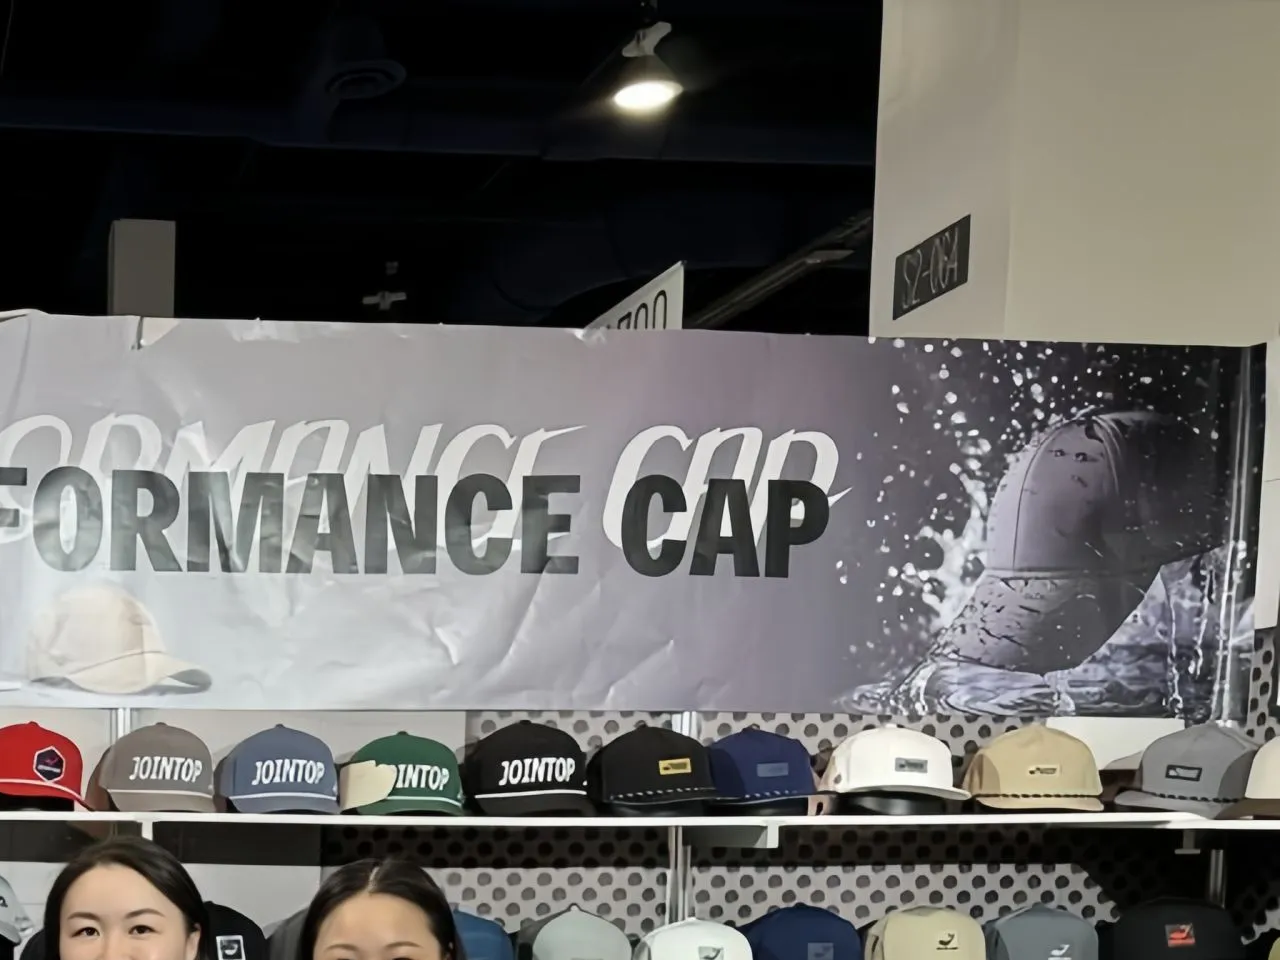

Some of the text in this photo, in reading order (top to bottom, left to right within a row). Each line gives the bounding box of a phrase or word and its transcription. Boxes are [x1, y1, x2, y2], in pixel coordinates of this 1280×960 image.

[621, 474, 831, 579] CAP
[129, 756, 203, 783] JOINTOP
[251, 759, 325, 786] JOINTOP
[395, 763, 450, 791] INTOP
[498, 756, 576, 786] JOINTOP
